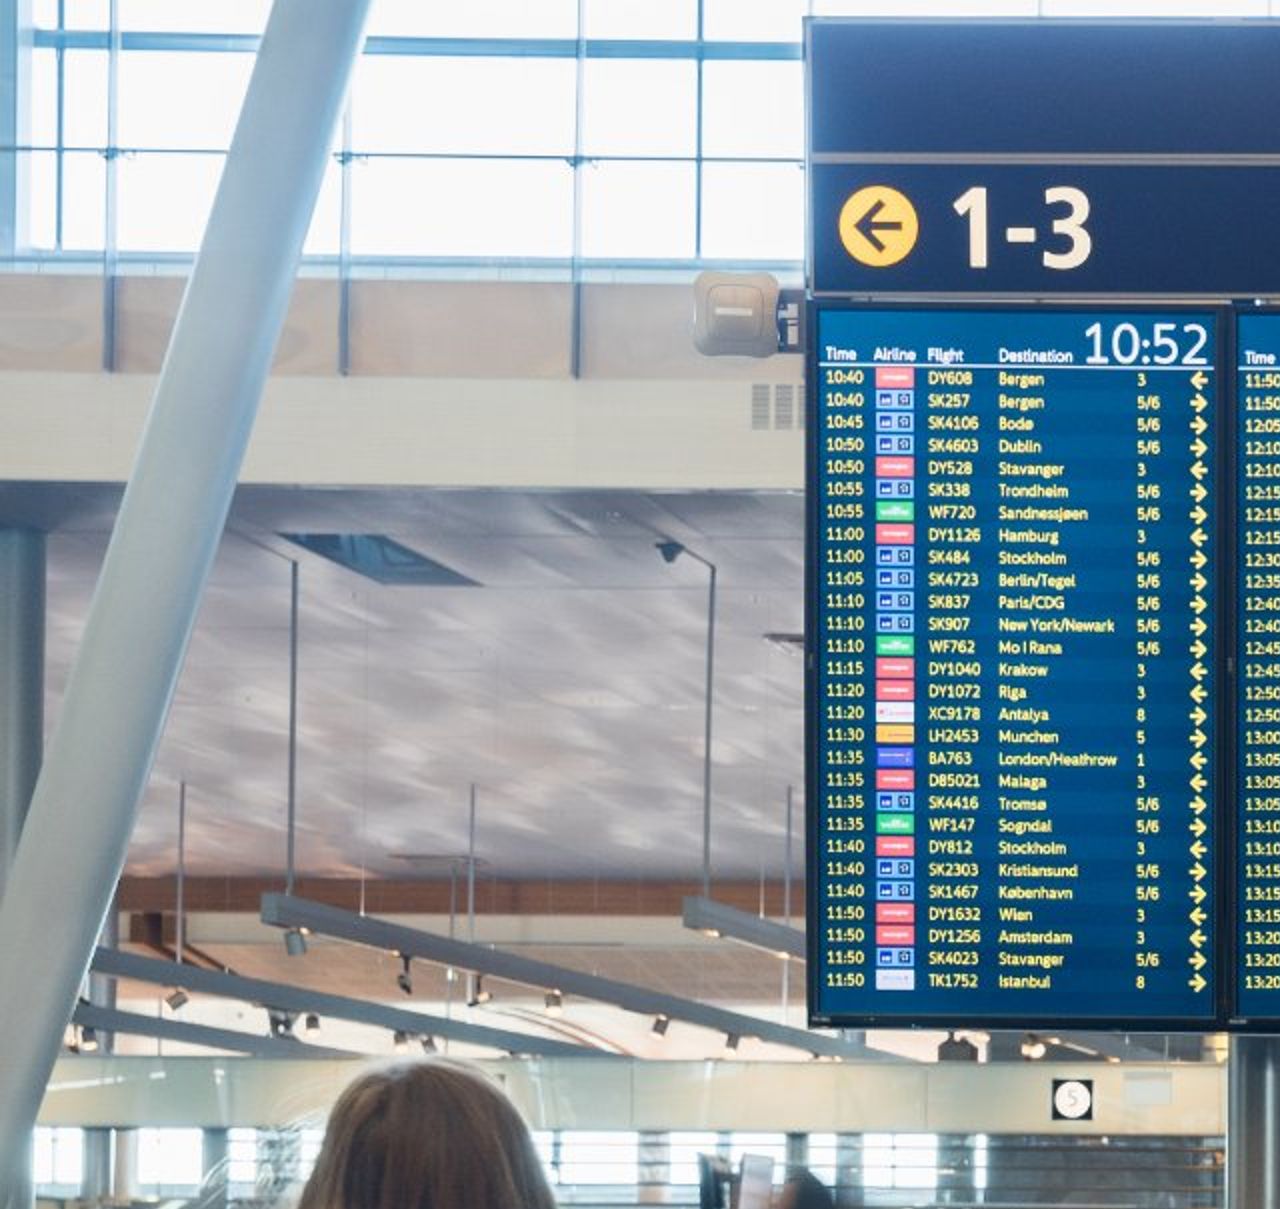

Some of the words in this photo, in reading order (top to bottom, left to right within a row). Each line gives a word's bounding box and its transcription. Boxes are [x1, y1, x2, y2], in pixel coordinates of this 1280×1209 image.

[954, 187, 1091, 269] 1-3
[1086, 323, 1207, 364] 10:52
[826, 346, 856, 360] Time
[874, 348, 916, 362] Airline
[928, 348, 964, 362] Flight
[999, 348, 1073, 362] Destination
[1246, 351, 1275, 364] Time
[827, 393, 864, 406] 10:40
[928, 394, 970, 408] SK257
[999, 394, 1044, 411] Bergen
[1138, 396, 1160, 410] 5/6
[828, 460, 864, 474] 10:50
[929, 461, 972, 475] DY528
[999, 462, 1064, 478] Stavanger
[828, 572, 864, 585] 11:05
[929, 572, 978, 586] SK4723
[999, 573, 1075, 590] Berlin/Tegel
[1137, 574, 1160, 588] 5/6
[828, 662, 864, 674] 11:15
[929, 662, 980, 676] DY1040
[999, 663, 1048, 676] Krakow
[1247, 664, 1280, 677] 12:45
[828, 728, 864, 741] 11:30
[929, 729, 978, 742] LH2453
[999, 730, 1058, 743] Munchen
[828, 818, 864, 830] 11:35
[930, 818, 974, 832] WF147
[999, 819, 1052, 835] Sogndal
[1137, 820, 1159, 833] 5/6
[828, 973, 864, 986] 11:50
[929, 974, 977, 987] TK1752
[1000, 975, 1050, 988] Istanbul
